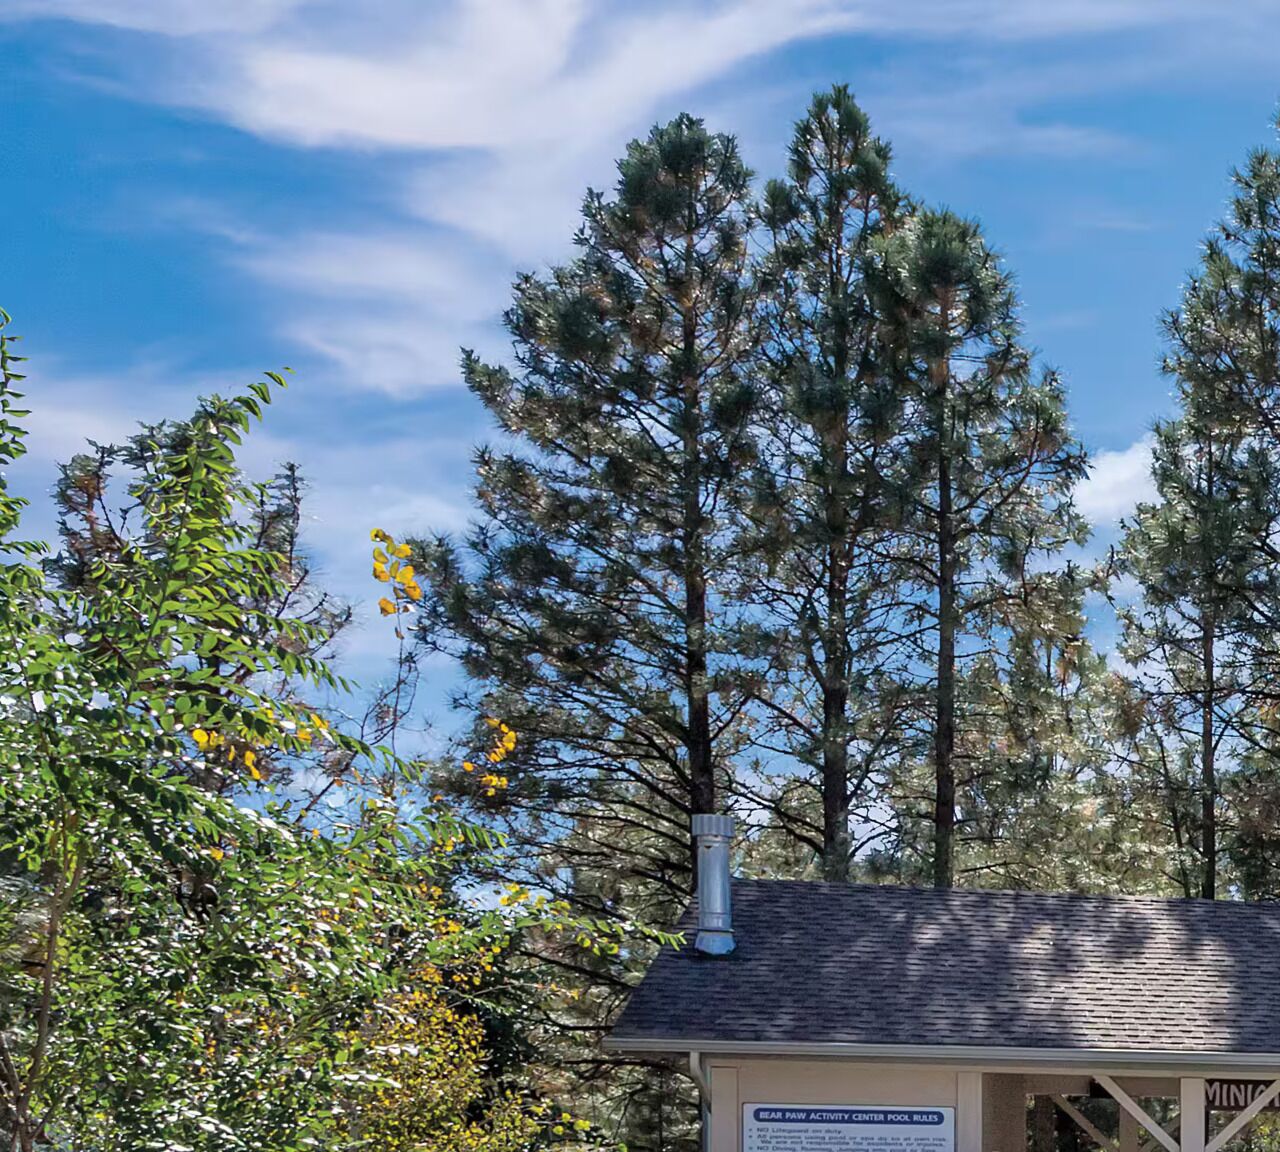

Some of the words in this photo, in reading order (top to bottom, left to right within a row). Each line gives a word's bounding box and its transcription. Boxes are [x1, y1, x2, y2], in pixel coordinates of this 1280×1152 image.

[760, 1111, 782, 1119] BEAR
[786, 1112, 806, 1120] PAW
[810, 1112, 849, 1120] ACTIVITY
[853, 1113, 884, 1121] CENTER
[913, 1114, 938, 1122] RULES
